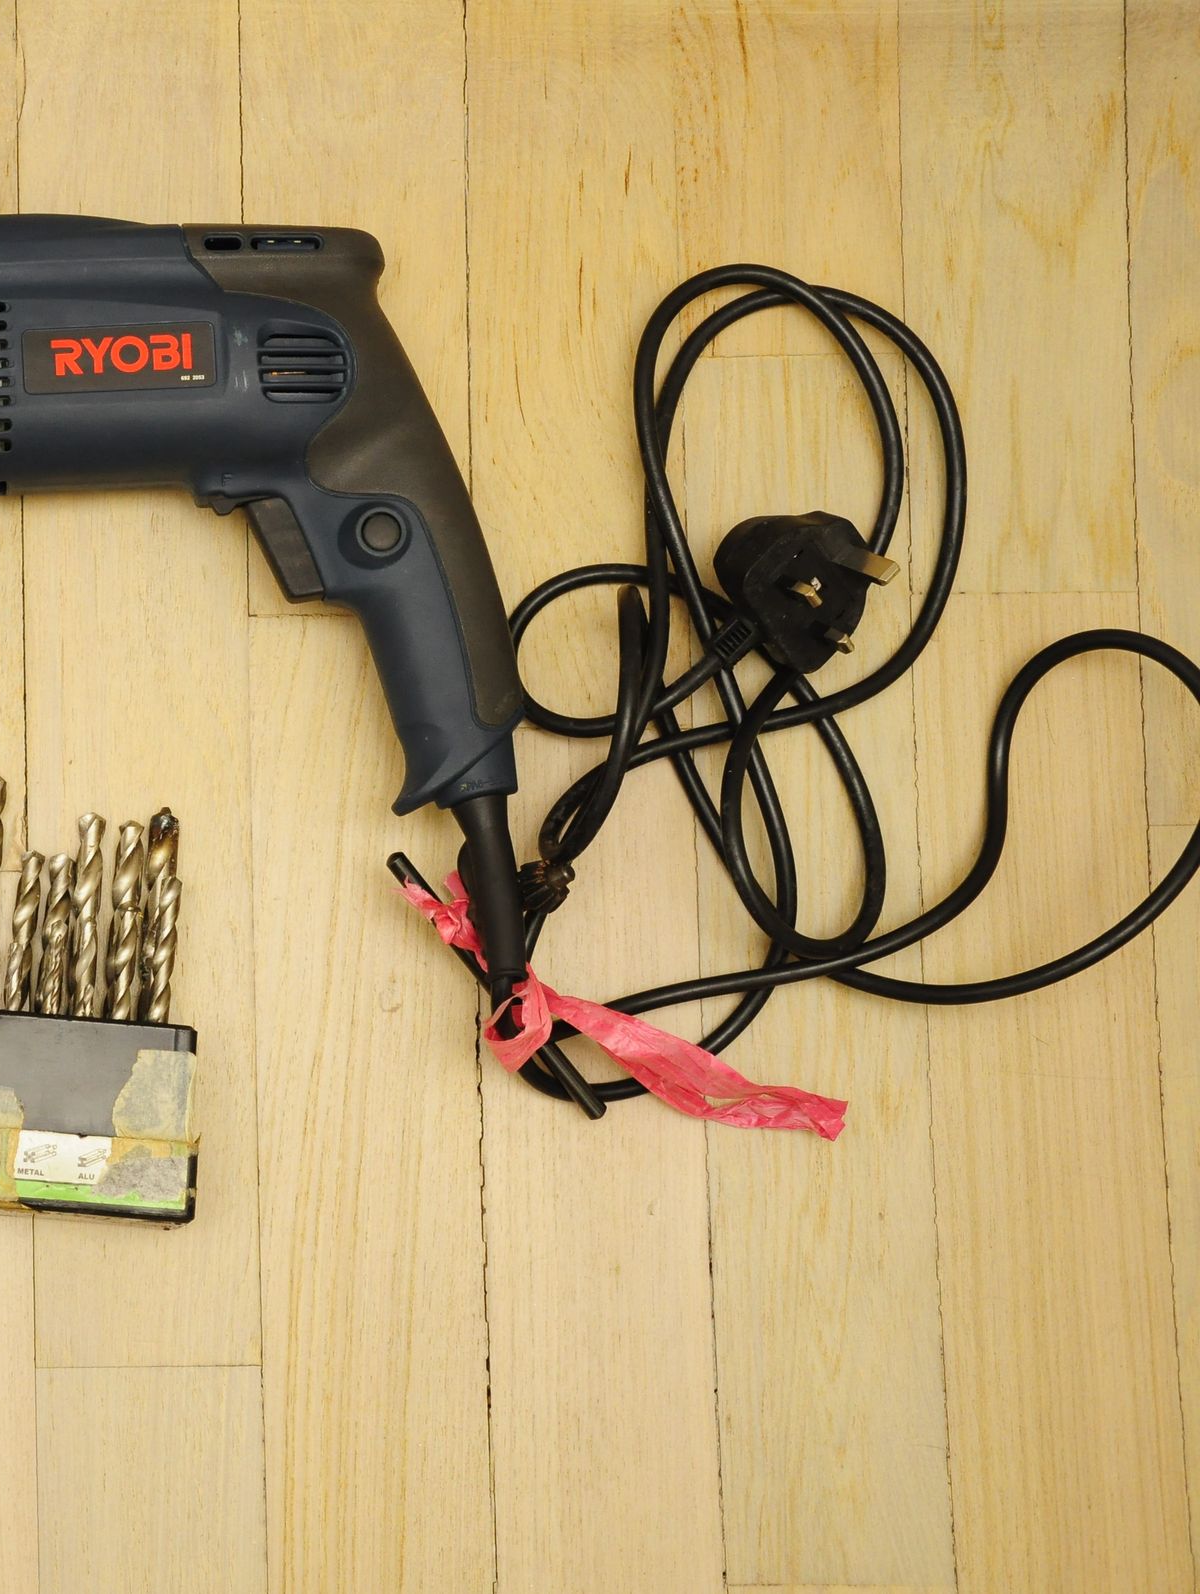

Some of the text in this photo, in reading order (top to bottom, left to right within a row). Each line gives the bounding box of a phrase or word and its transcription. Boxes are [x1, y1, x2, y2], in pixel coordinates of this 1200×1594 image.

[51, 333, 193, 376] RYOBI
[17, 1167, 45, 1177] METAL
[78, 1172, 96, 1181] ALU
